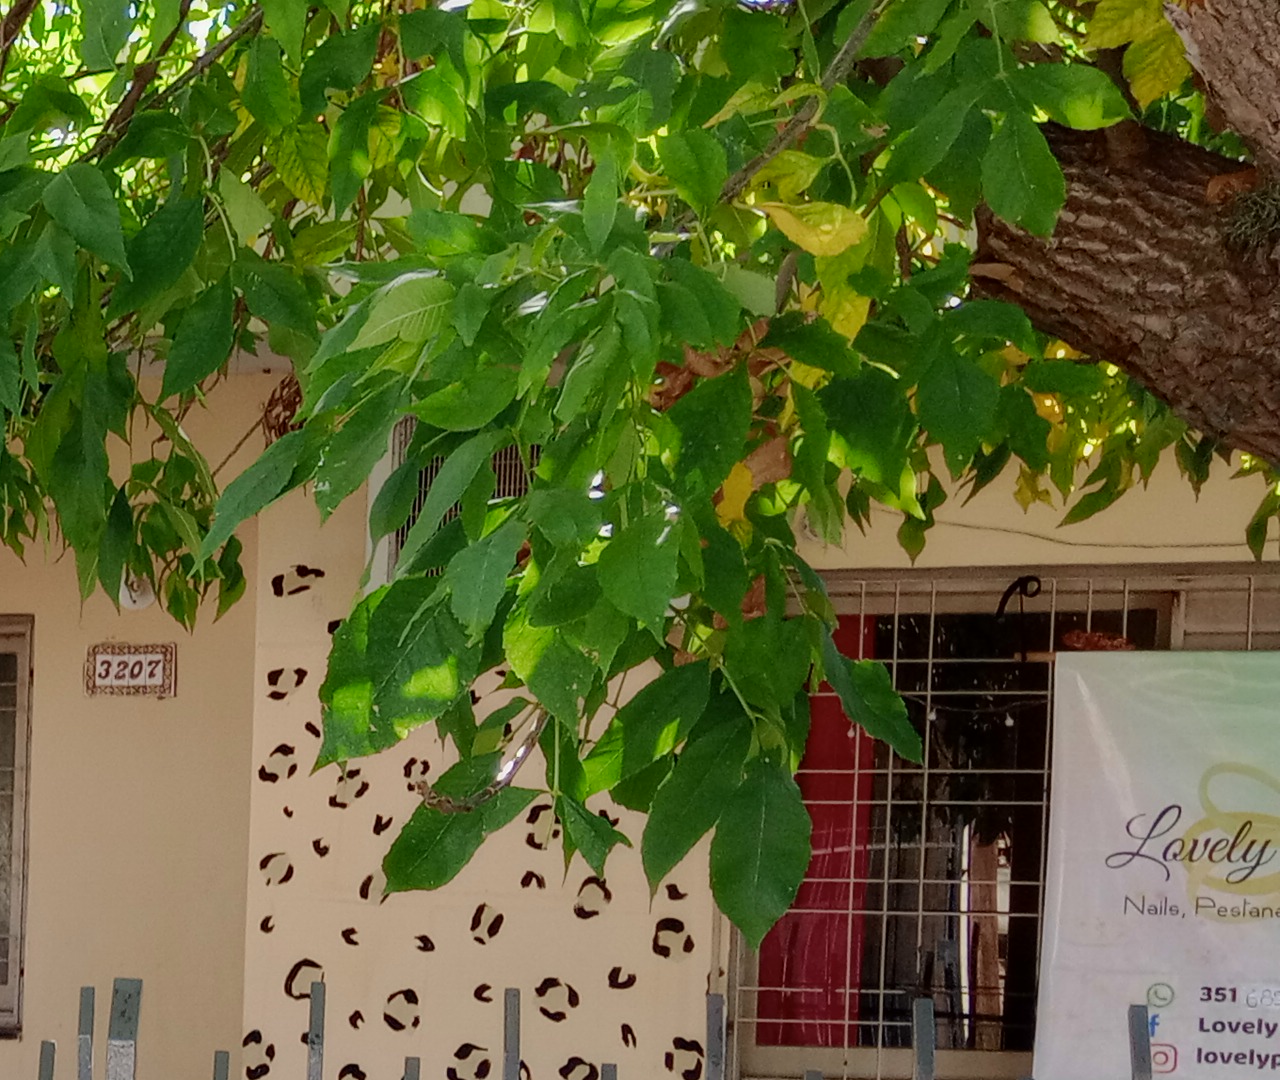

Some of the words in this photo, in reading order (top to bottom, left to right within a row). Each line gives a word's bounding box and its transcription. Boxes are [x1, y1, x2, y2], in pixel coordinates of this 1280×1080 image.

[97, 659, 162, 681] 3207
[1104, 804, 1278, 885] Lovely
[1123, 894, 1186, 919] Nails,
[1199, 986, 1238, 1003] 351
[1198, 1017, 1279, 1039] Lovely
